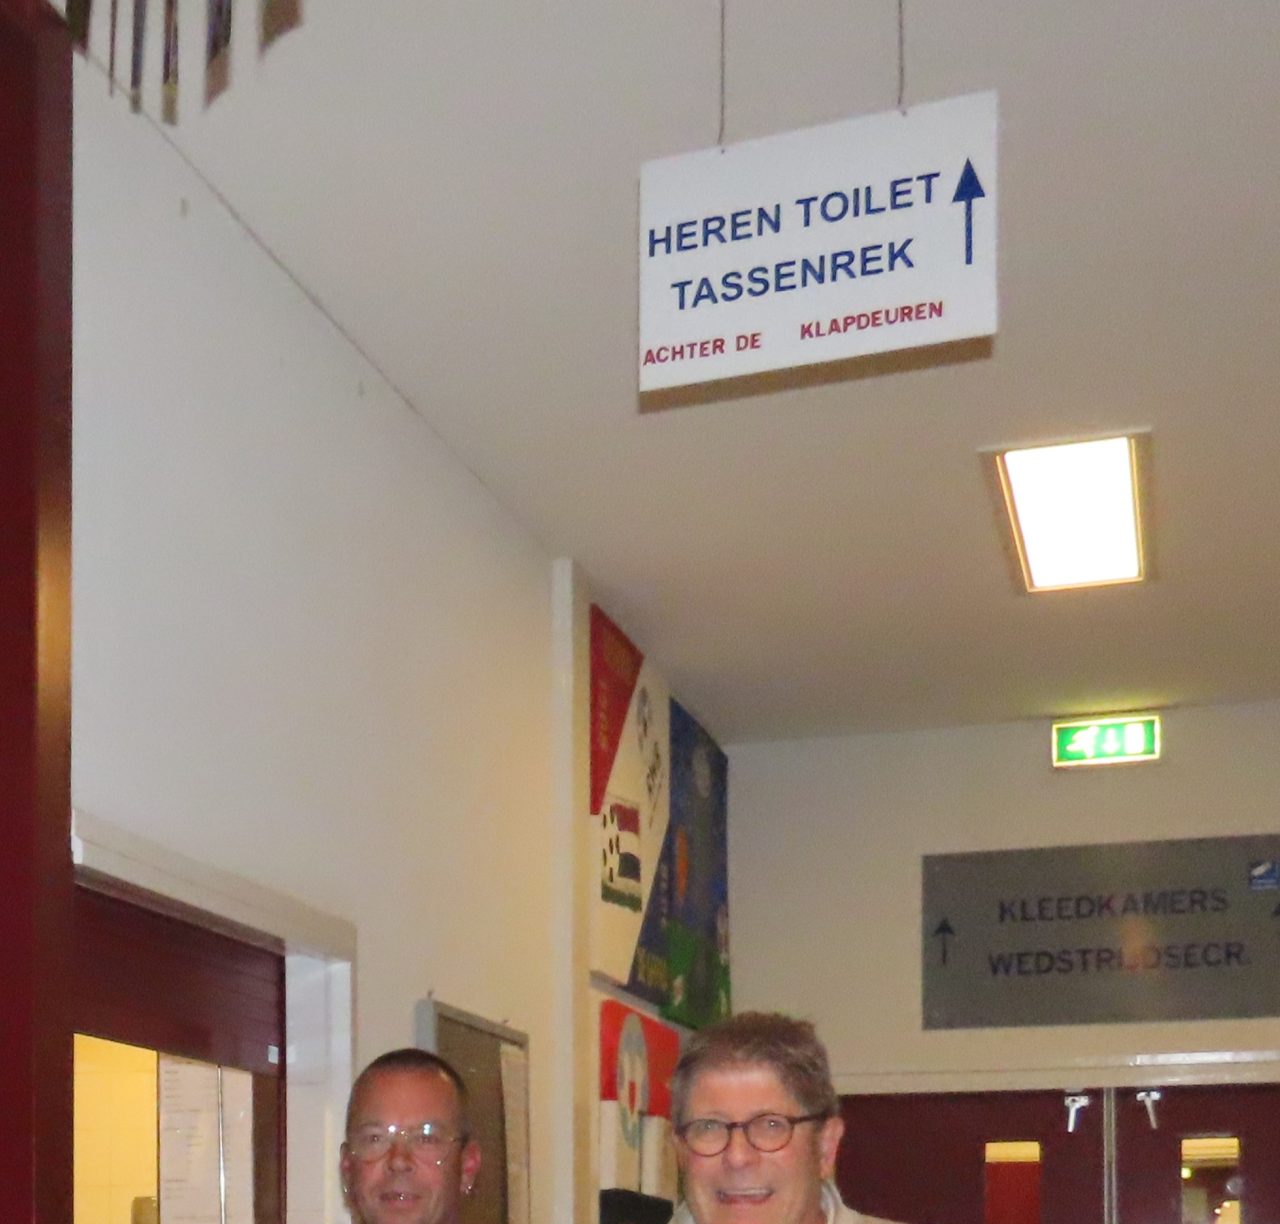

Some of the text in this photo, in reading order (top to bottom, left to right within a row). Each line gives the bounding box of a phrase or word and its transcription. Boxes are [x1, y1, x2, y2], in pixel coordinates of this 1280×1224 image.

[648, 172, 941, 257] HEREN TOILET
[671, 238, 915, 311] TASSENREK
[642, 301, 945, 366] ACHTER DE KLAPDEUREN
[997, 888, 1229, 923] KLEEDKAMERS
